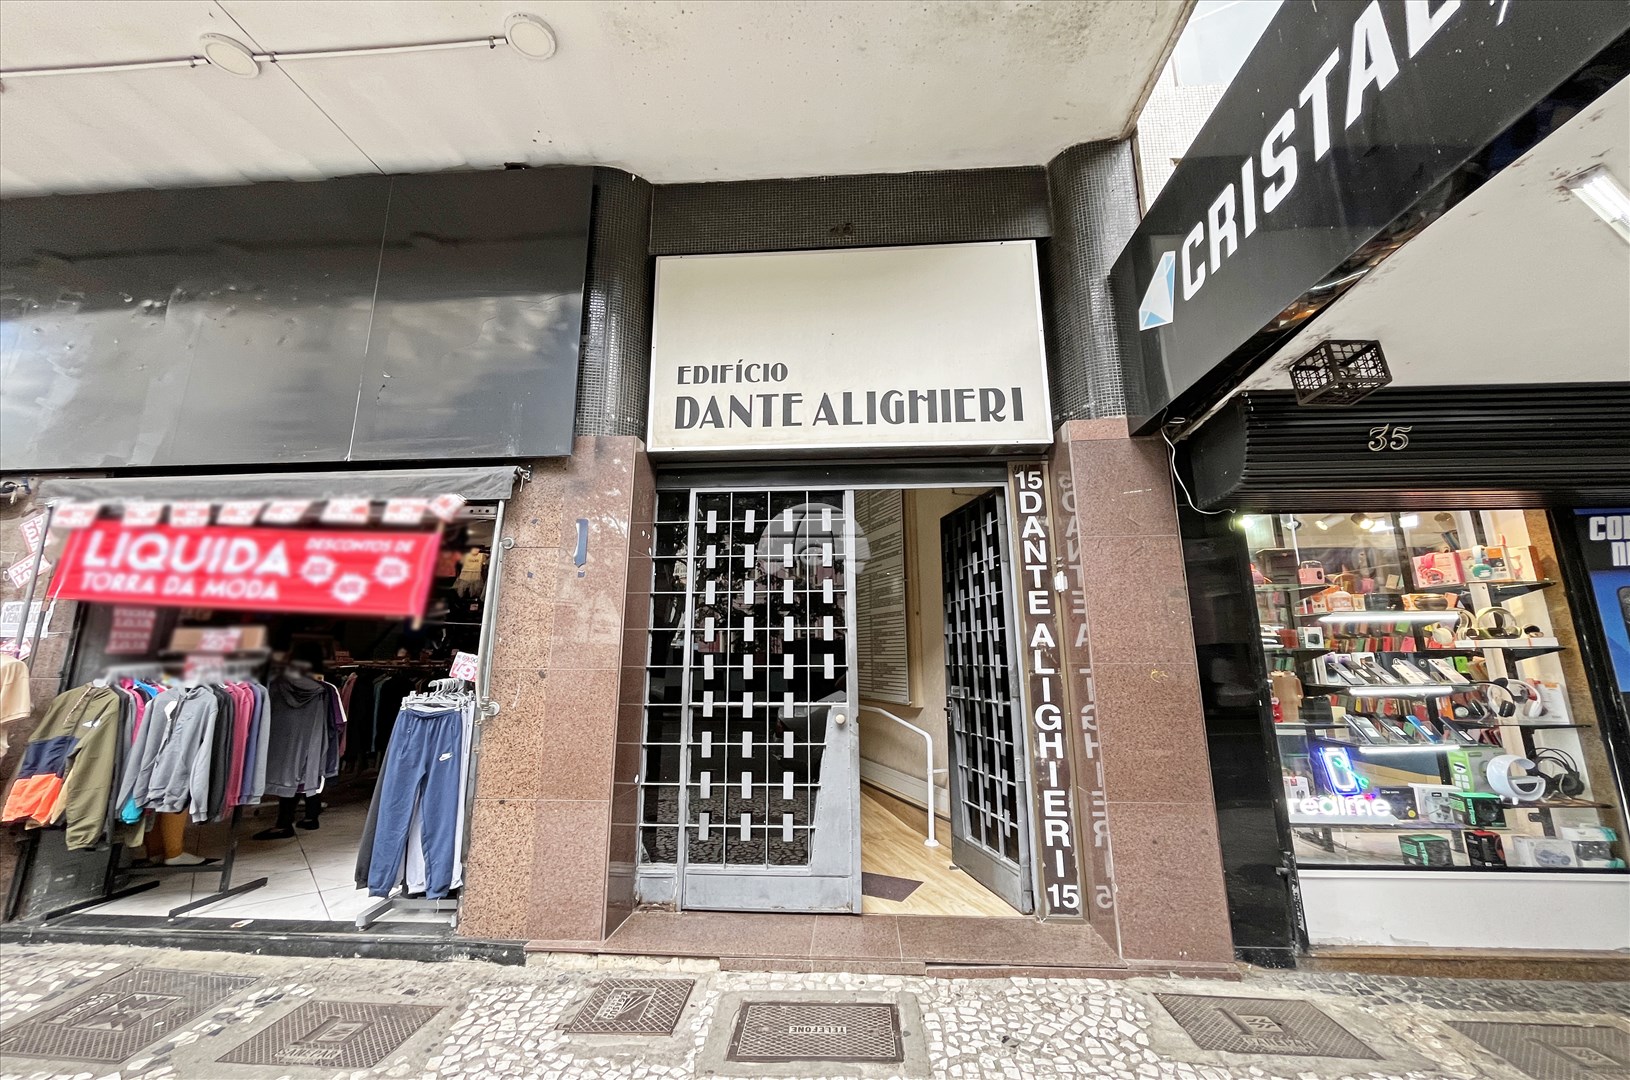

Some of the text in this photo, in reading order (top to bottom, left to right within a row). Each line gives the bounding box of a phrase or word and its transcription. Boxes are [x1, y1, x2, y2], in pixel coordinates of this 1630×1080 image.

[677, 359, 788, 385] EDIFÍCIO
[675, 387, 1024, 430] DANTE ALIGHIERI
[1368, 423, 1413, 451] 35
[1015, 471, 1042, 489] 15
[82, 531, 290, 576] LIQUIDA
[305, 538, 392, 552] DESCONTOS
[80, 571, 279, 600] TORRA DA MODA
[1019, 491, 1071, 878] DANTE ALIGHIERI
[1288, 796, 1391, 817] realme
[1048, 884, 1080, 908] 15
